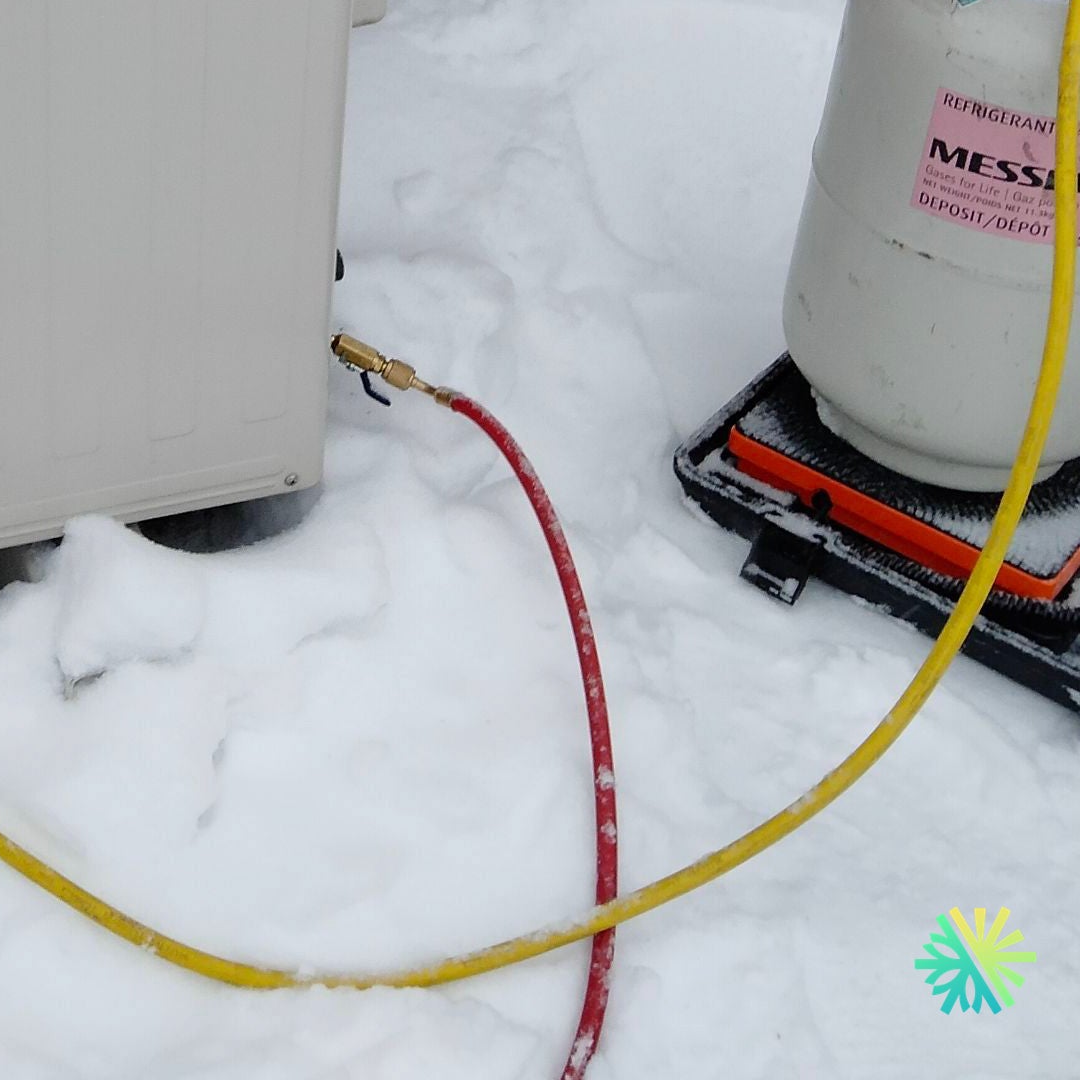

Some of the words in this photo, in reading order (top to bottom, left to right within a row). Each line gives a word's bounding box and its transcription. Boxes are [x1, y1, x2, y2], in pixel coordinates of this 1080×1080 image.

[925, 164, 956, 184] Gases
[959, 177, 976, 189] for
[979, 183, 1001, 197] Life
[1012, 191, 1036, 205] Gaz
[929, 137, 1080, 192] MESS
[919, 191, 1051, 237] DEPOSIT/DÉPÔT
